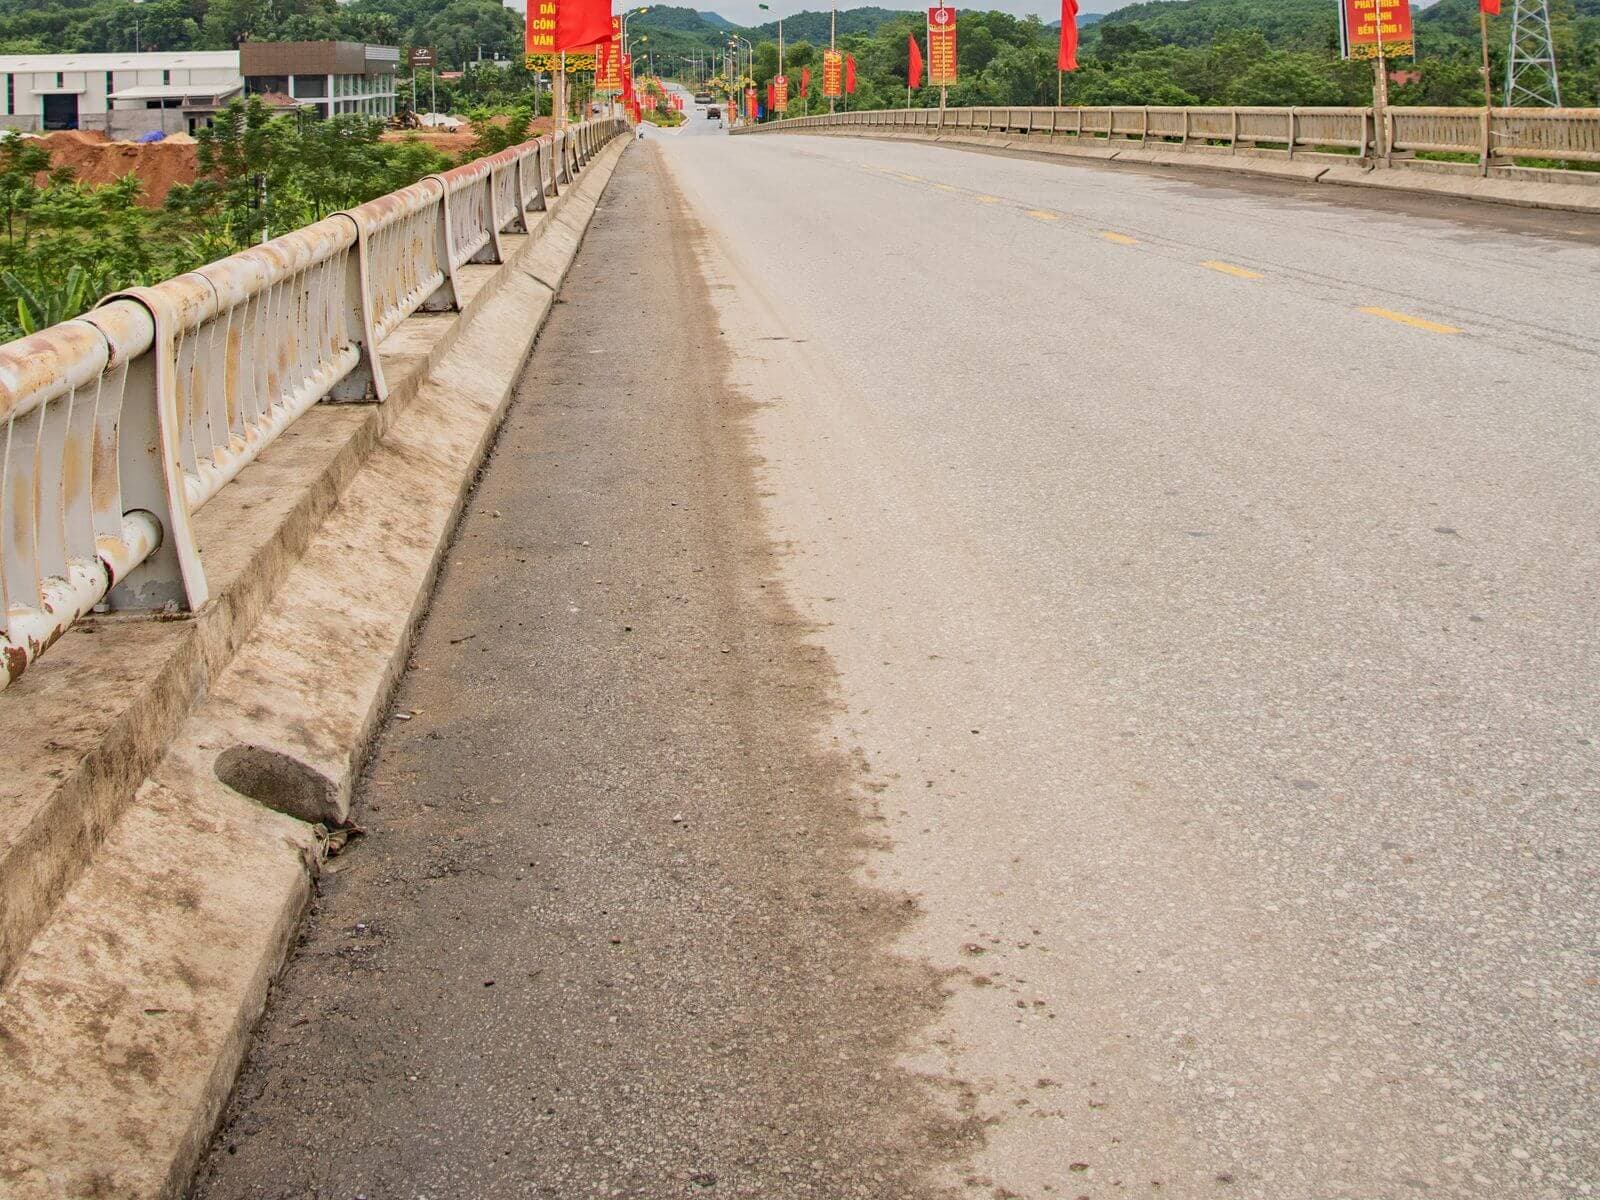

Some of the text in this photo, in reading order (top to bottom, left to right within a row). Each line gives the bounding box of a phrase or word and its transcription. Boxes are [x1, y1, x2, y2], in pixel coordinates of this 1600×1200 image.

[539, 2, 556, 15] DÂ
[1355, 0, 1375, 9] PHÁT
[533, 34, 554, 45] VĂN
